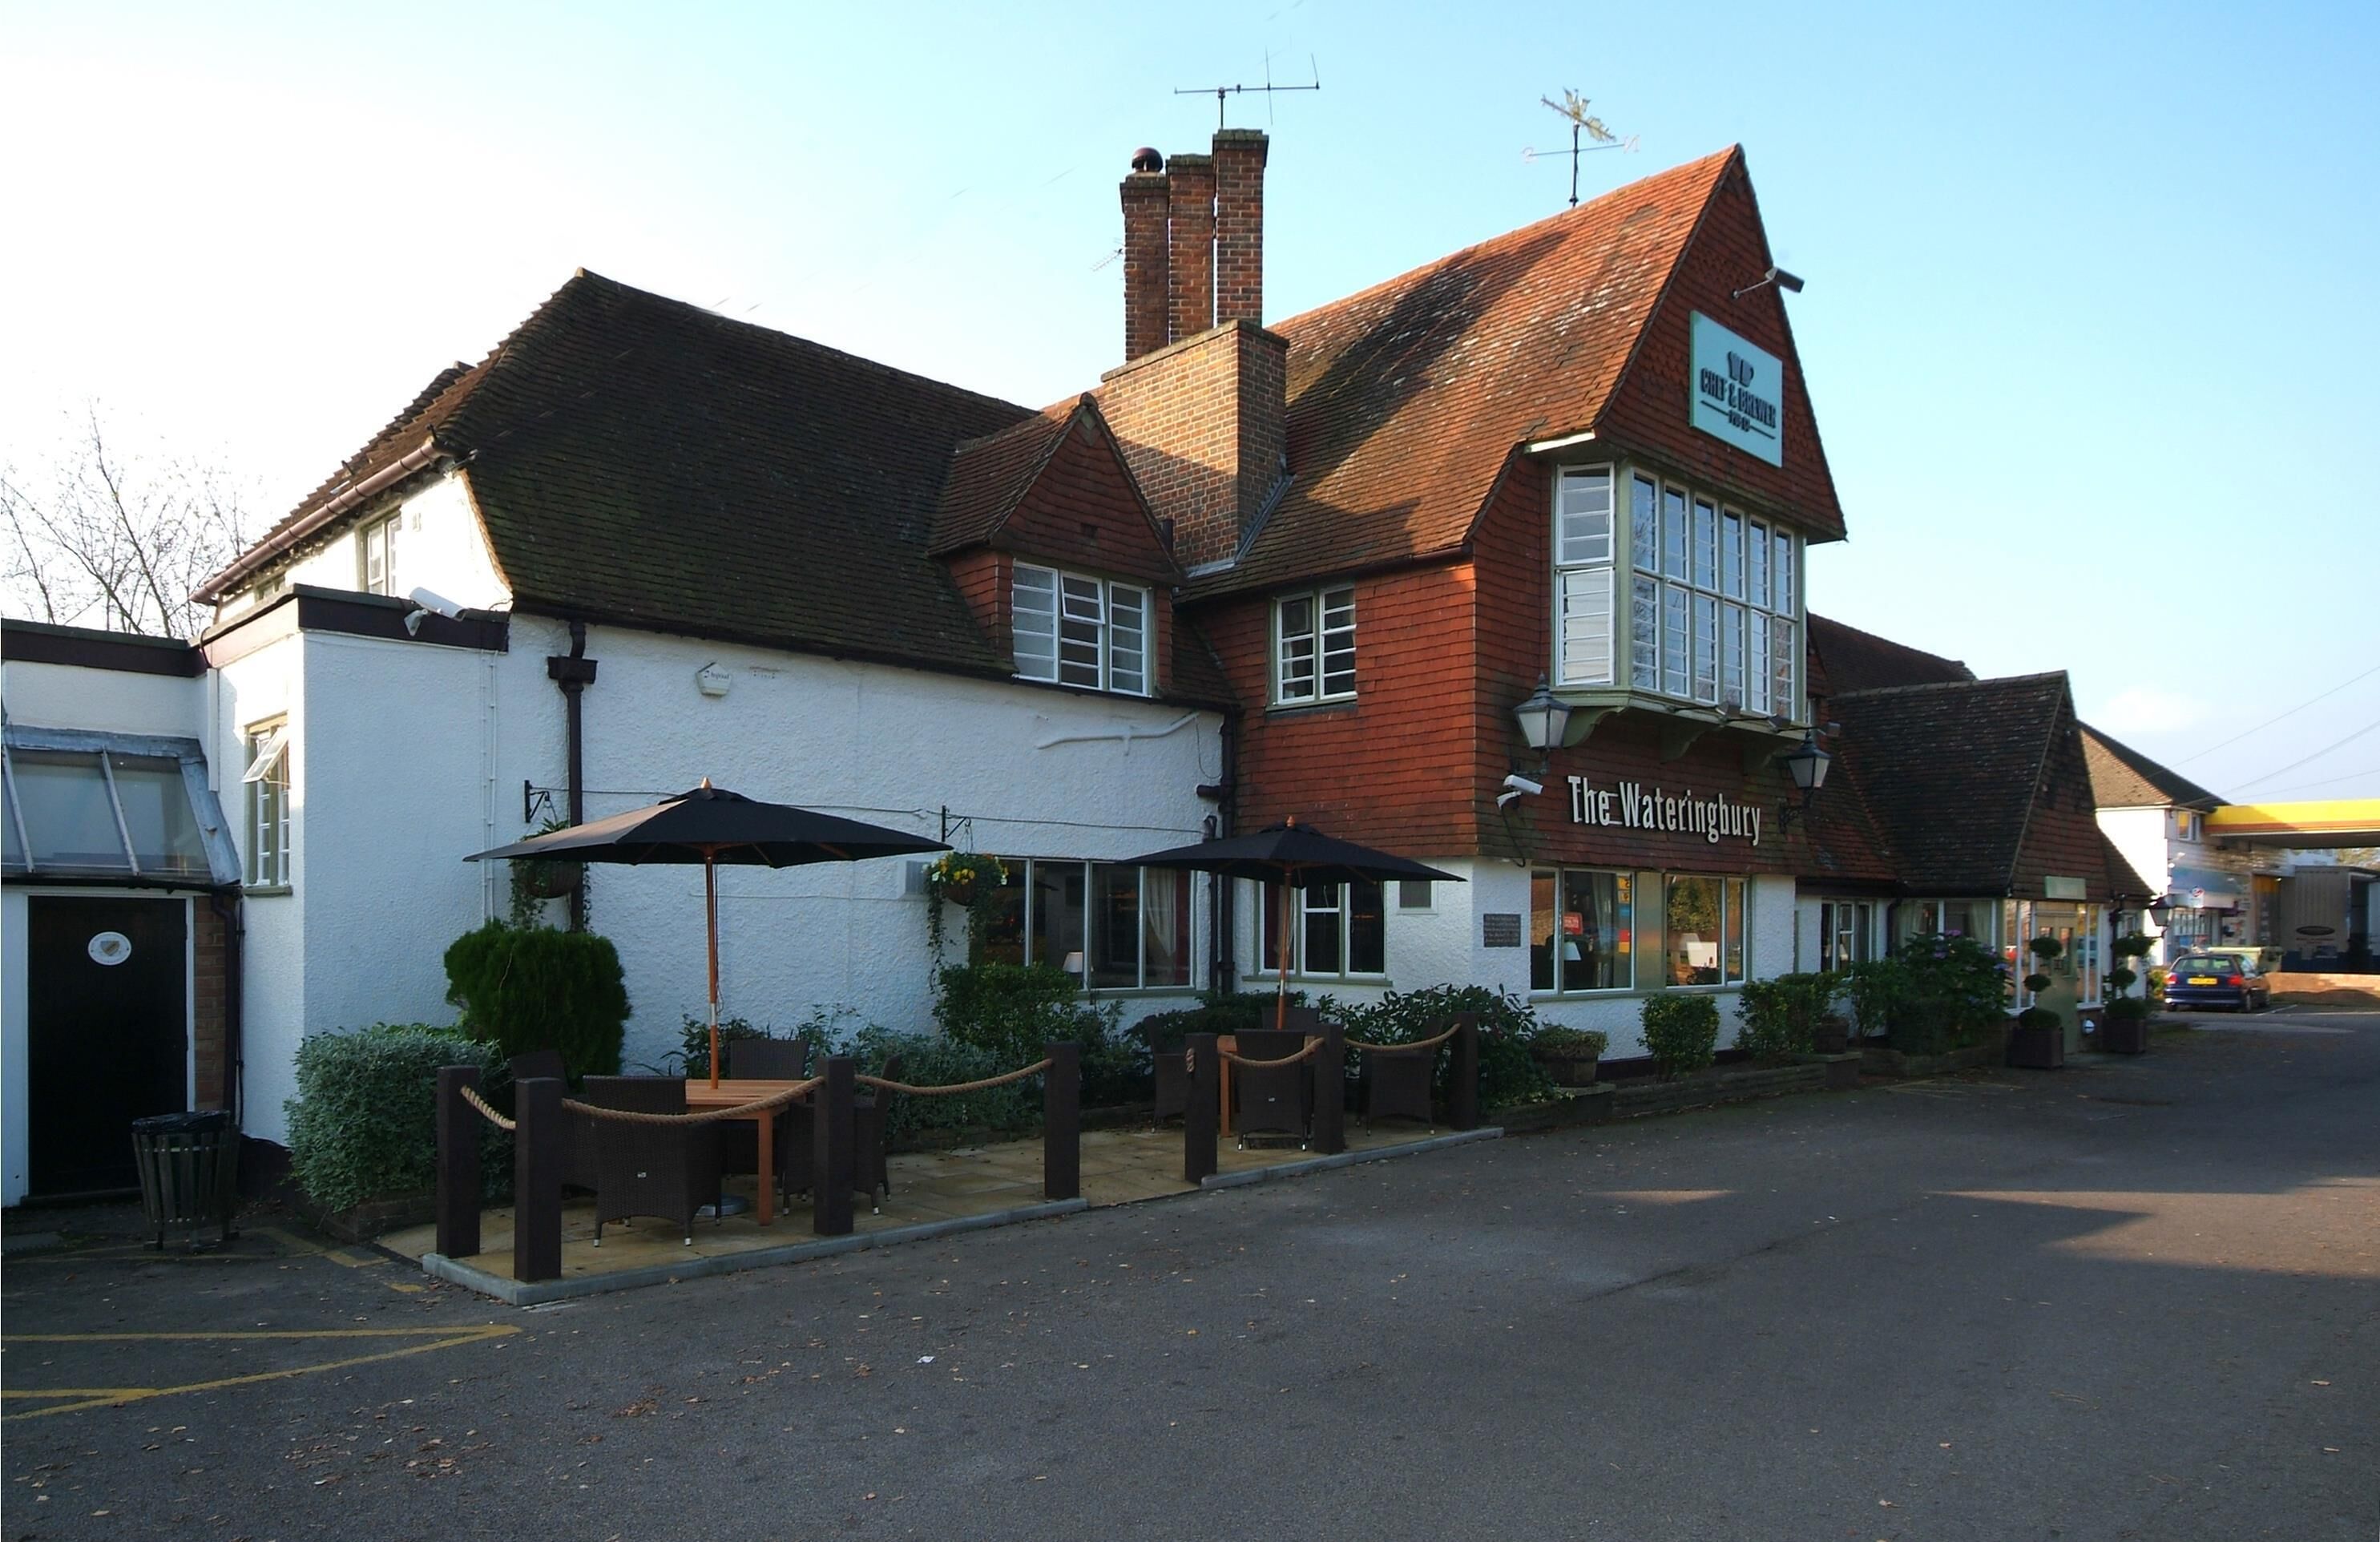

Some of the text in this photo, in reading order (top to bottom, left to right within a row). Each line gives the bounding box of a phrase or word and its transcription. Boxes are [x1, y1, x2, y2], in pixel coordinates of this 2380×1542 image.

[1700, 368, 1727, 402] CHEF
[1728, 382, 1737, 409] &
[1738, 387, 1776, 428] BREWER
[1567, 775, 1761, 846] The Wateringbury
